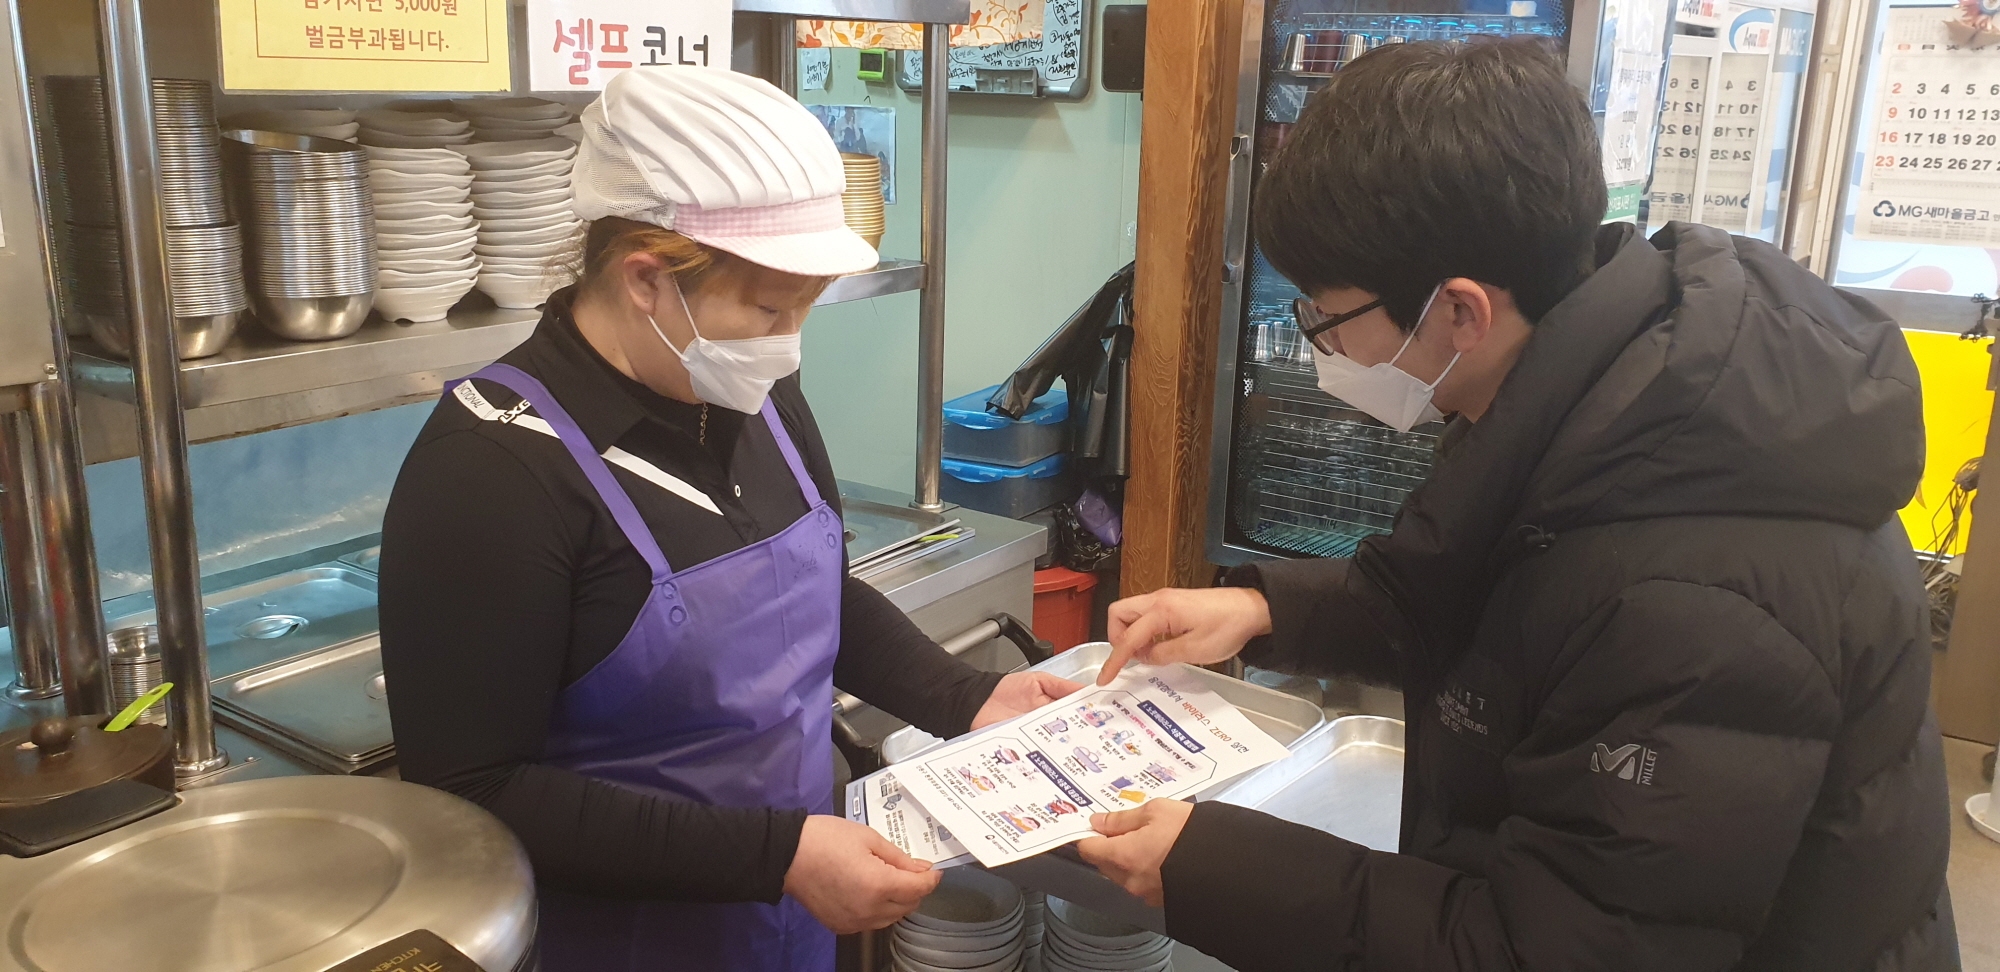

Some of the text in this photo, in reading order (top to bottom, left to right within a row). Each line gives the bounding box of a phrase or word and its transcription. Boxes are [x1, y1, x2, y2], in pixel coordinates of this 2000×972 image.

[306, 25, 450, 52] 벌금부과됩니다.
[1892, 82, 2000, 95] 2 3 4 5 6
[1888, 107, 2000, 121] 9 10 11 12 13
[1880, 132, 1997, 146] 16 17 18 19 20
[1875, 156, 1993, 171] 23 24 25 26 27
[1182, 702, 1210, 726] 바이러스
[1210, 727, 1232, 741] ZERO
[1642, 749, 1658, 785] MILLET
